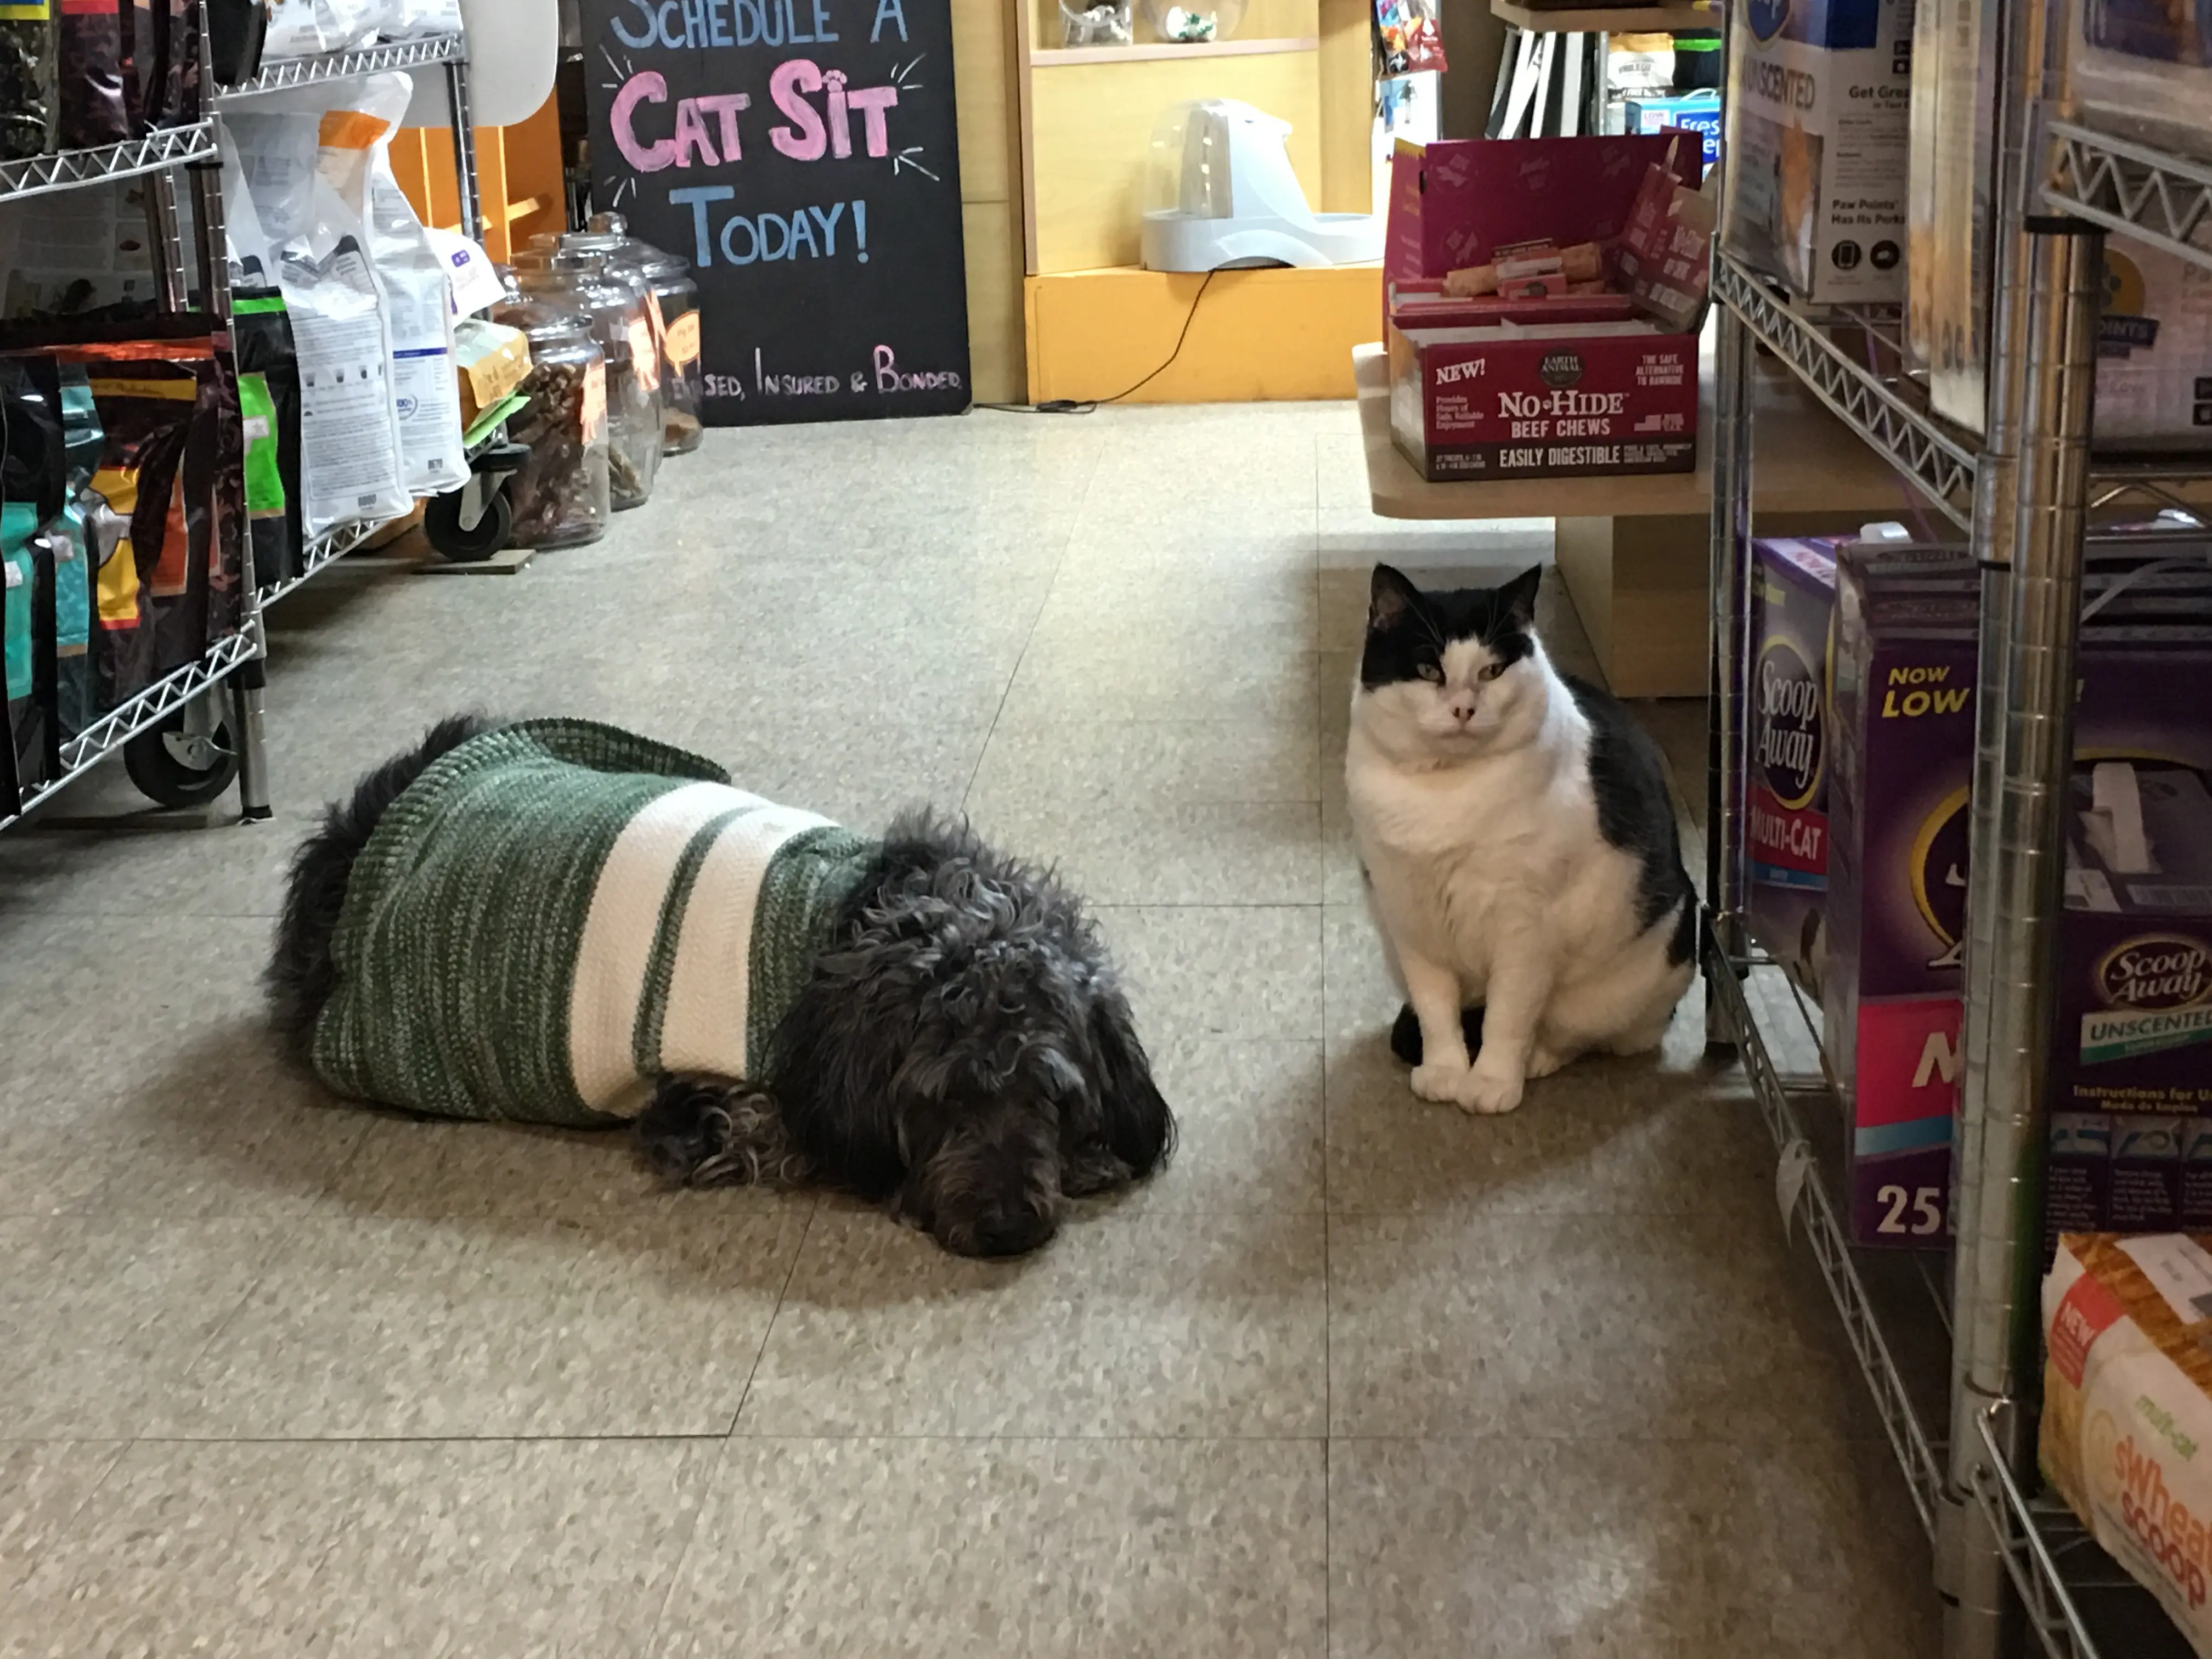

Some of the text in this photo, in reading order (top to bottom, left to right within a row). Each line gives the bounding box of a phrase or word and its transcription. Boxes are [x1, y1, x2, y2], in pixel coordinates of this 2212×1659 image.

[1849, 85, 1910, 98] Get Grea
[610, 71, 751, 172] CAT
[1680, 119, 1720, 136] Fres
[669, 185, 870, 267] TODAY!
[850, 371, 868, 393] &
[1436, 358, 1485, 385] NEW!
[1511, 418, 1610, 438] BEEF CHEWS
[1499, 448, 1544, 468] EASILY
[1548, 445, 1621, 466] DIGESTIBLE
[1888, 665, 1950, 686] NOW
[1758, 659, 1818, 730] Scoop
[1882, 688, 1971, 718] LOW
[1755, 716, 1814, 789] Away
[1750, 805, 1821, 861] MULTI-CAT
[2110, 950, 2206, 980] Scoop
[2111, 972, 2202, 1003] Away
[2073, 1084, 2166, 1100] Instructions
[2169, 1087, 2193, 1100] for
[2121, 1491, 2206, 1611] scoop
